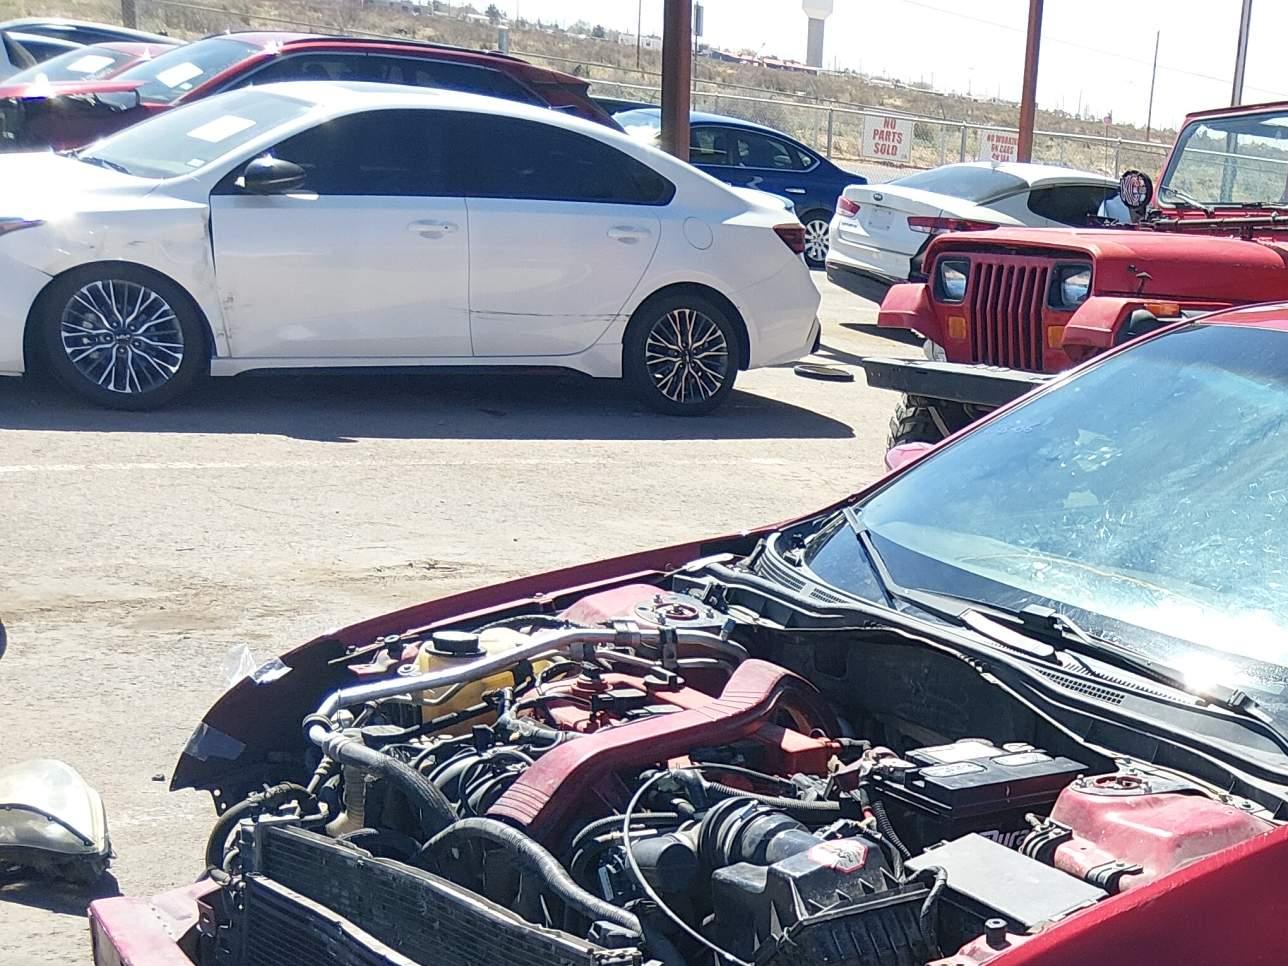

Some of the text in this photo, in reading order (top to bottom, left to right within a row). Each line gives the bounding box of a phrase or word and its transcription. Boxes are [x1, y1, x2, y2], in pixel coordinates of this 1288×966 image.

[883, 116, 897, 130] NO
[872, 129, 903, 145] PARTS
[873, 142, 898, 156] SOLD
